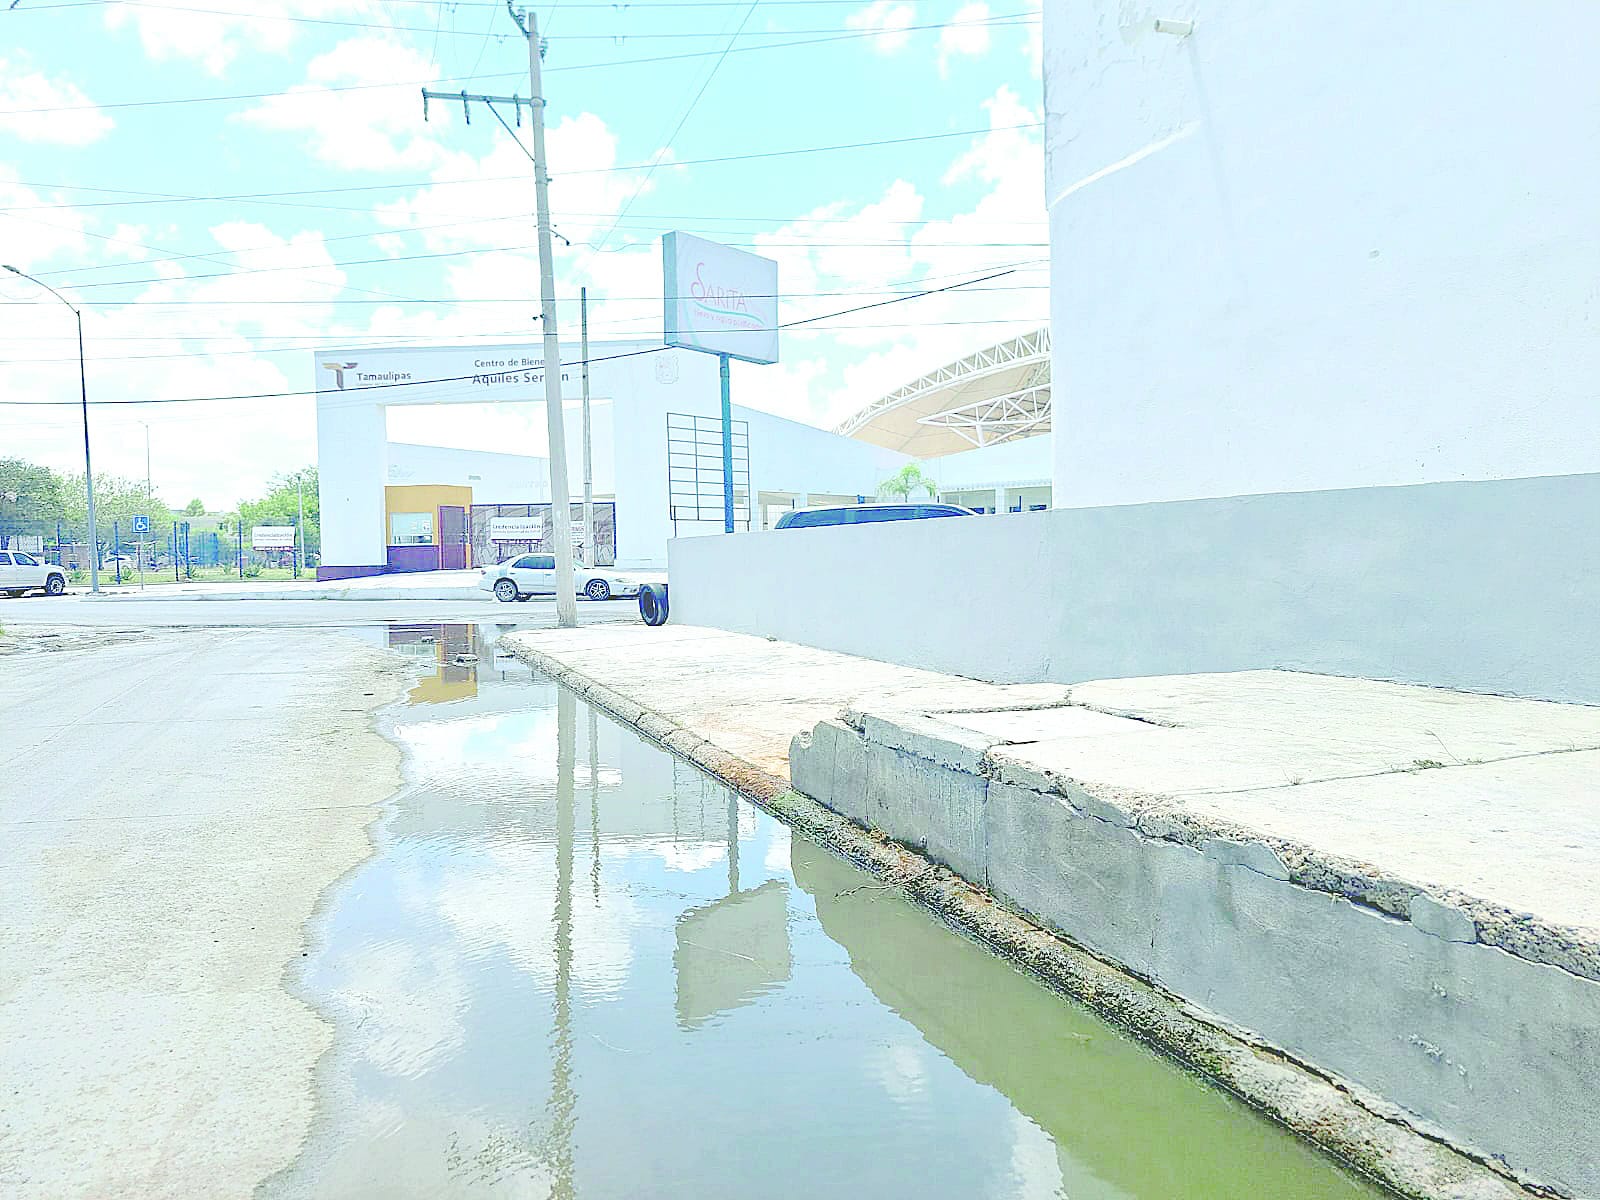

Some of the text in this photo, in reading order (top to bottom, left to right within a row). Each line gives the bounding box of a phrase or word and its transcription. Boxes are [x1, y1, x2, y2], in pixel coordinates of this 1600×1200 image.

[690, 262, 748, 312] SARITA
[474, 359, 505, 368] Centro
[508, 358, 518, 367] de
[356, 371, 412, 383] Tamaulipas
[472, 372, 569, 387] Aquiles Sern
